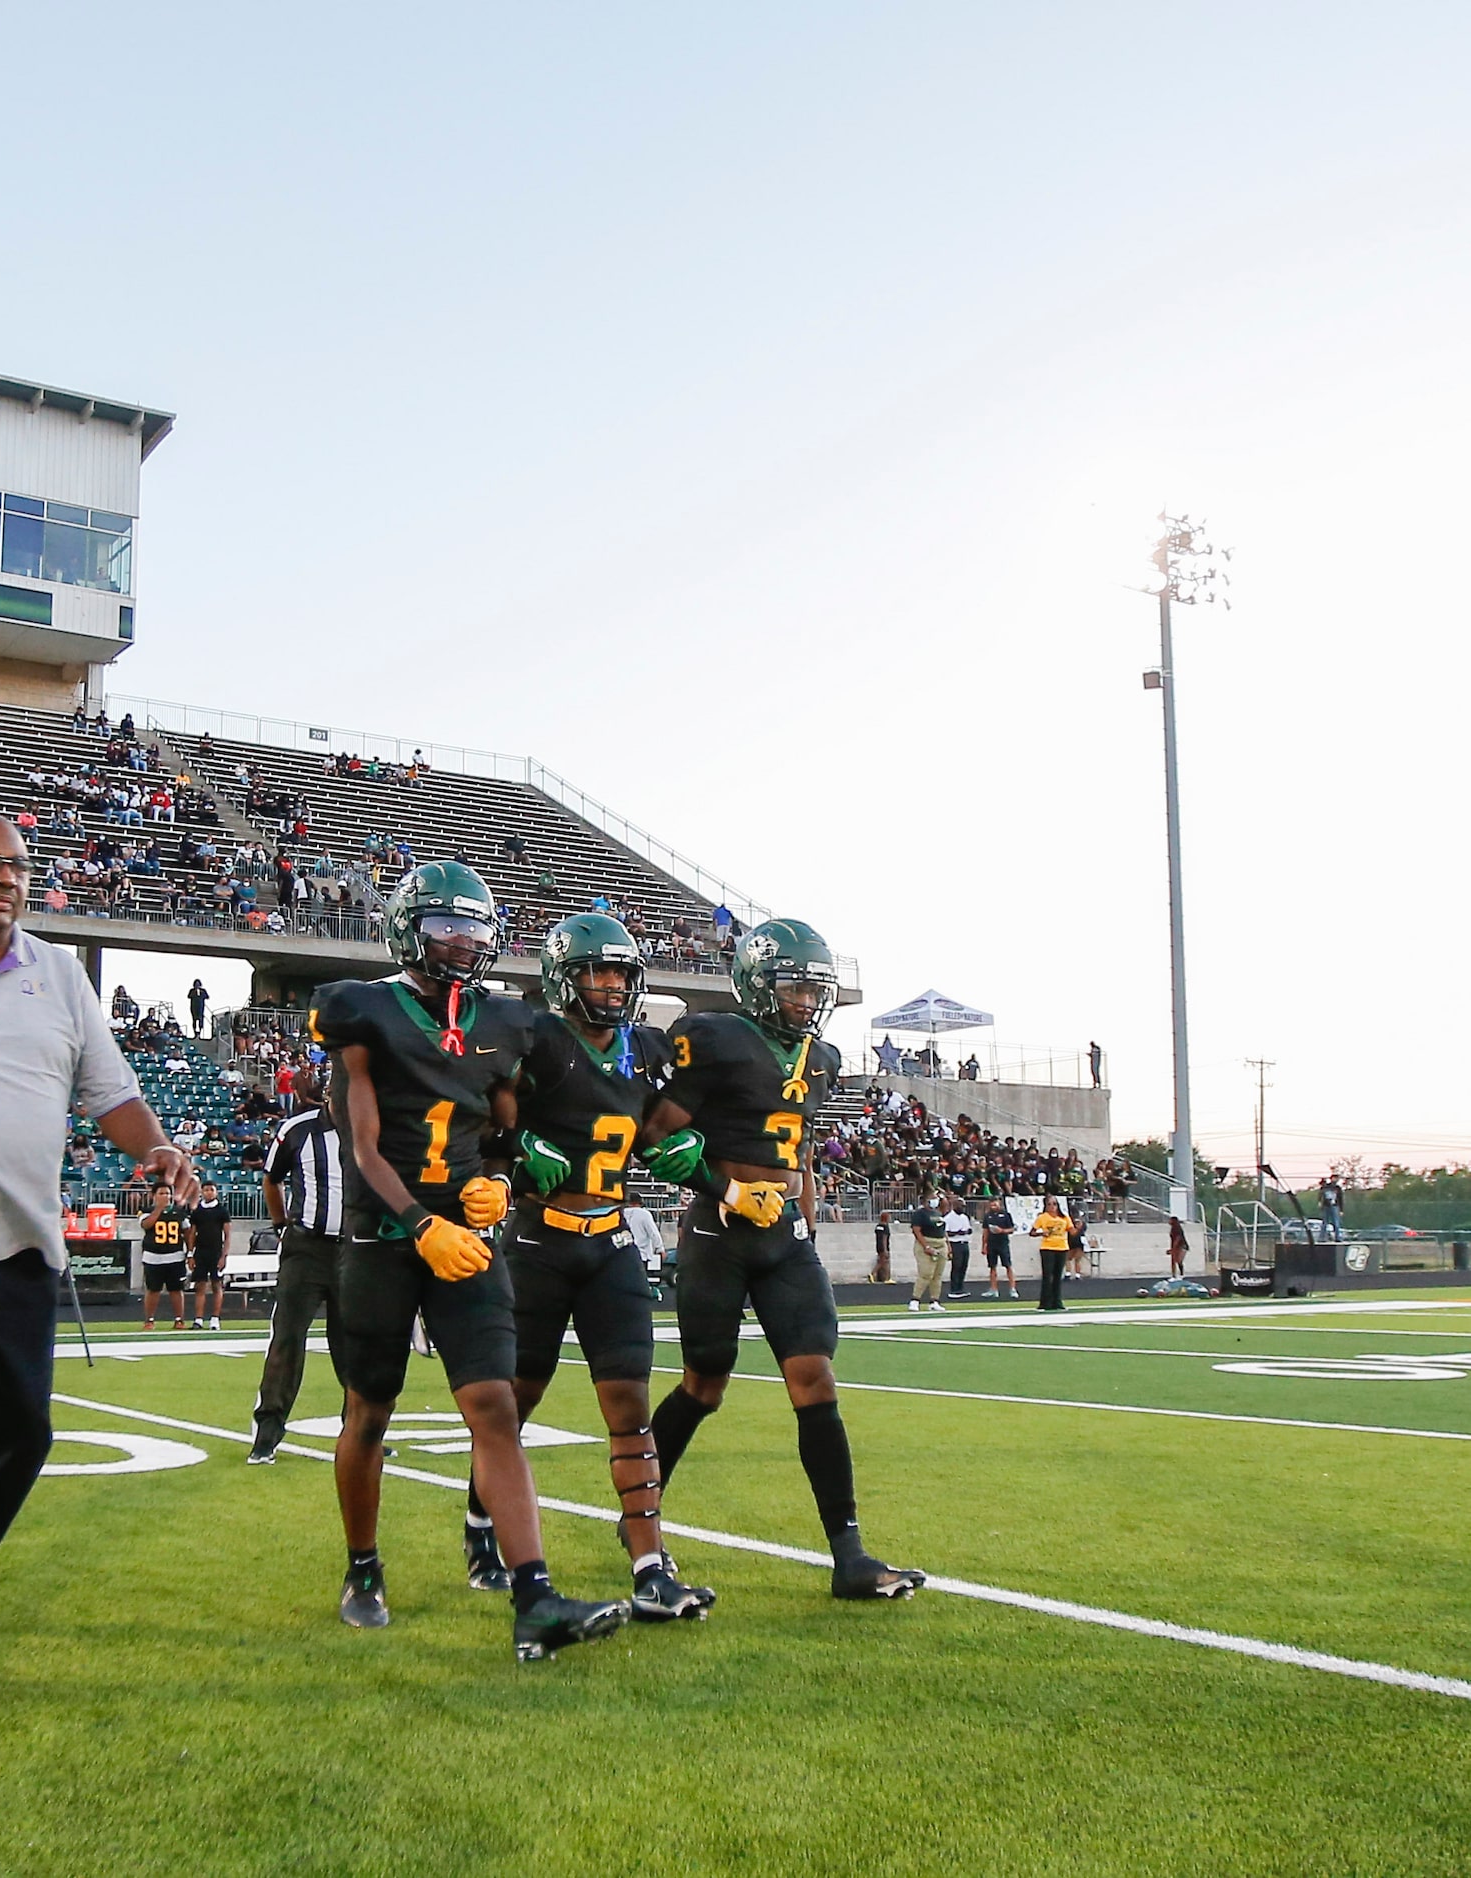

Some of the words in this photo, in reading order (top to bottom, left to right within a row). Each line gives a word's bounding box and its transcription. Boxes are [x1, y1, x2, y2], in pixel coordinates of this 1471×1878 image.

[311, 730, 326, 740] 201
[673, 1035, 692, 1067] 3
[419, 1100, 456, 1184] 1
[585, 1115, 638, 1200] 2
[763, 1112, 805, 1170] 3
[154, 1221, 180, 1245] 99
